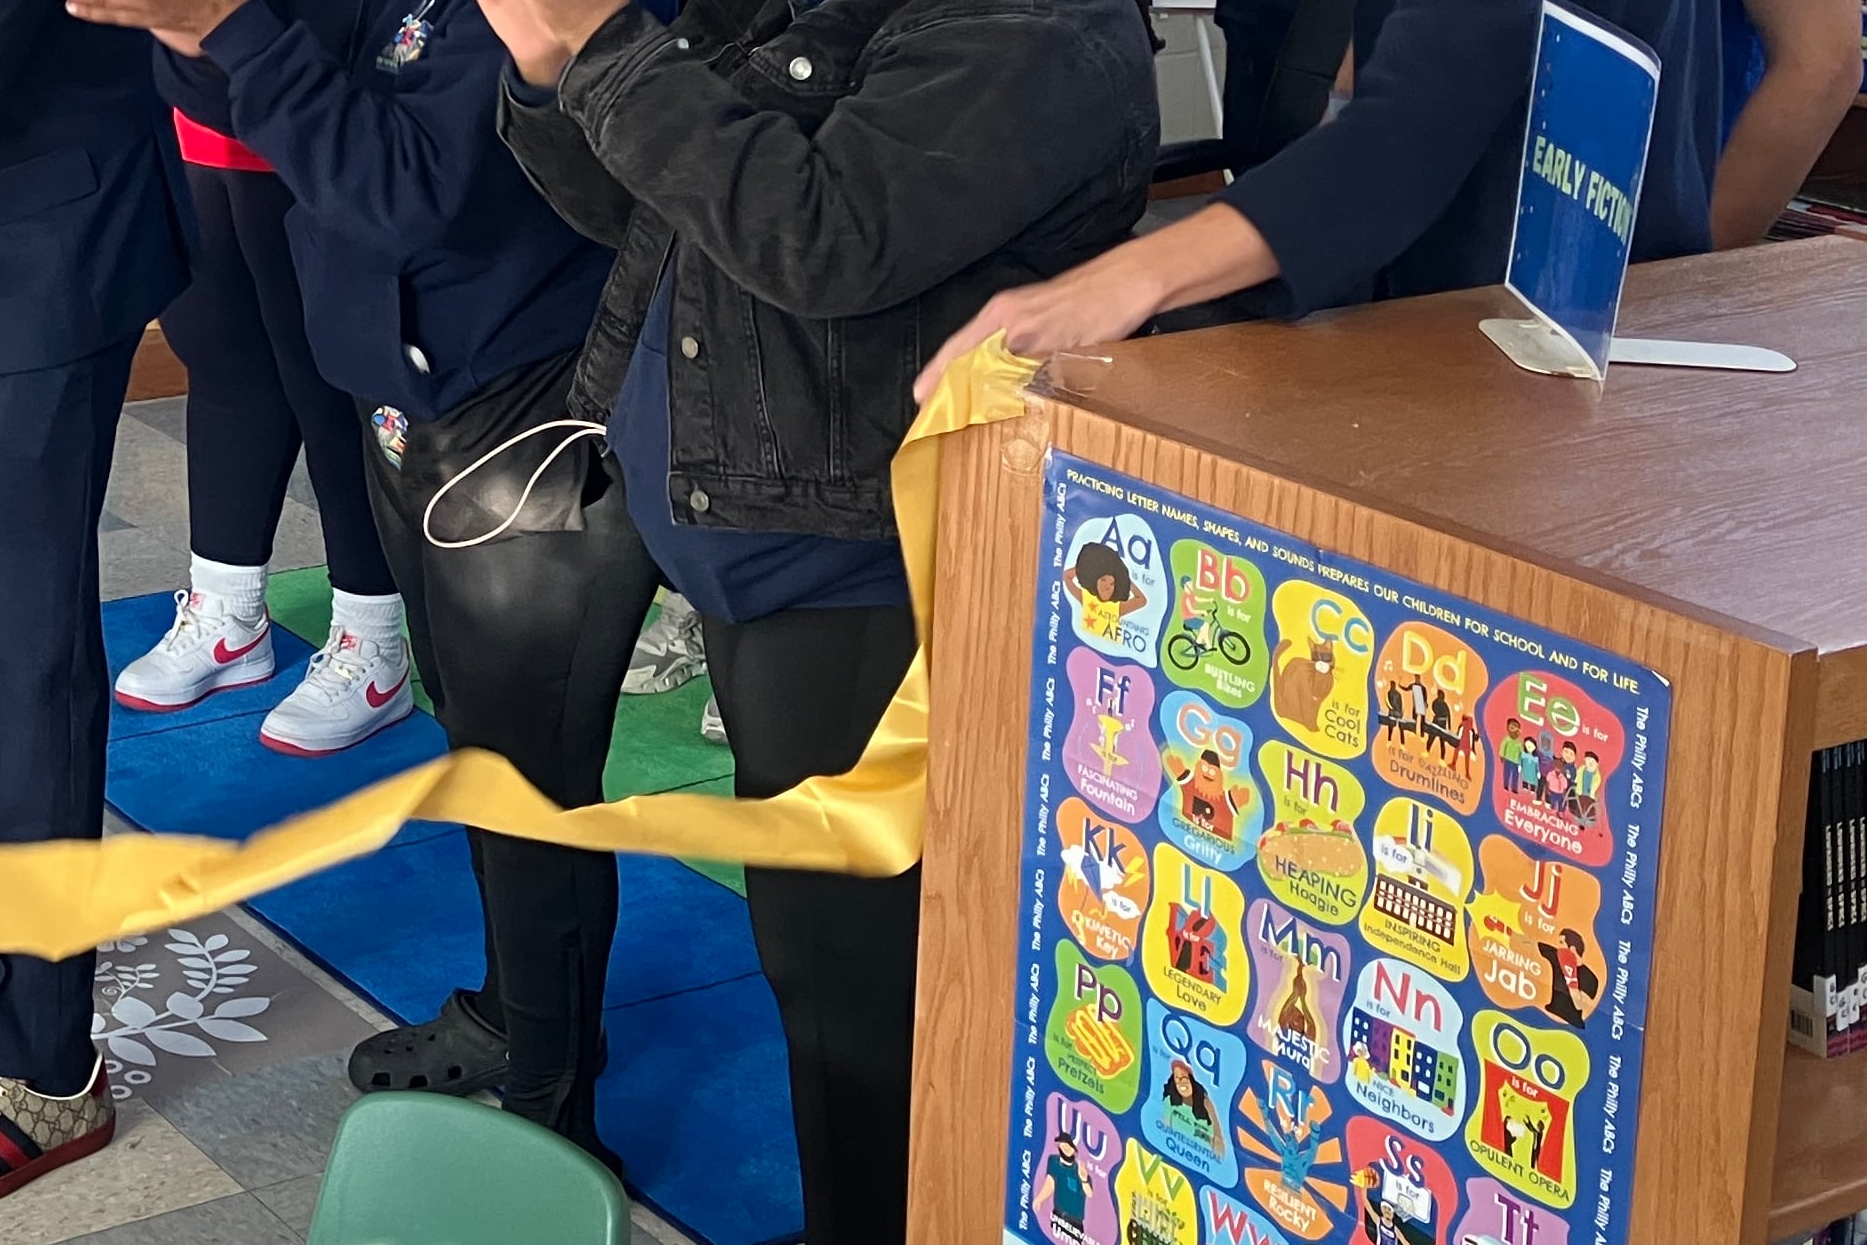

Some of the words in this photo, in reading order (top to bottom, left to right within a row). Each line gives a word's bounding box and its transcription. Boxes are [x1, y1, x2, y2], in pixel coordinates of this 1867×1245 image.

[1533, 135, 1586, 200] EARLY
[1586, 170, 1633, 246] FICTION
[1055, 513, 1067, 545] Philly
[1100, 517, 1152, 570] Aa
[1054, 550, 1063, 567] The
[1067, 469, 1123, 500] PRACTICING
[1127, 491, 1159, 511] LETTER
[1162, 506, 1199, 530] NAMES,
[1203, 520, 1241, 546] SHAPES,
[1245, 536, 1268, 553] AND
[1273, 546, 1314, 572] SOUNDS
[1318, 564, 1369, 593] PREPARES
[1374, 585, 1398, 603] OUR
[1402, 596, 1460, 626] CHILDREN
[1465, 618, 1489, 637] FOR
[1493, 629, 1545, 659] SCHOOL
[1549, 650, 1578, 669] AND
[1583, 662, 1609, 683] FOR
[1196, 548, 1251, 604] Bb
[1048, 612, 1060, 644] Philly
[1102, 624, 1146, 652] AFRO
[1047, 646, 1057, 665] The
[1402, 630, 1467, 695] Dd
[1095, 667, 1131, 716] Ff
[1204, 663, 1255, 693] BUSTLING
[1216, 679, 1242, 698] Bikes
[1324, 709, 1360, 734] Cool
[1332, 700, 1339, 710] is
[1345, 702, 1360, 718] for
[1517, 671, 1581, 737] Ee
[1636, 706, 1649, 730] The
[1043, 708, 1054, 738] Philly
[1177, 703, 1244, 770] Gg
[1324, 725, 1359, 748] Cats
[1582, 724, 1590, 736] is
[1593, 726, 1610, 743] for
[1042, 741, 1051, 761] The
[1631, 733, 1647, 771] Philly
[1078, 764, 1138, 801] FASCINATING
[1080, 778, 1136, 816] Fountain
[1285, 749, 1339, 813] Hh
[1390, 759, 1465, 804] Drumlines
[1630, 773, 1643, 809] ABCs
[1038, 804, 1050, 834] Philly
[1283, 796, 1290, 807] is
[1293, 801, 1307, 817] for
[1510, 799, 1580, 836] EMBRACING
[1037, 840, 1047, 856] The
[1172, 817, 1235, 854] GREGARIOUS
[1504, 809, 1583, 855] Everyone
[1627, 824, 1640, 847] The
[1184, 835, 1223, 865] Gritty
[1381, 843, 1389, 855] is
[1391, 848, 1407, 864] for
[1275, 855, 1357, 908] HEAPING
[1621, 850, 1638, 888] Philly
[1289, 880, 1339, 916] Hoagie
[1519, 860, 1562, 918] Jj
[1032, 899, 1044, 931] Philly
[1524, 911, 1532, 926] is
[1537, 918, 1555, 935] for
[1620, 889, 1634, 925] ABCs
[1032, 932, 1041, 951] The
[1085, 917, 1131, 949] KINETIC
[1097, 936, 1119, 959] Key
[1259, 902, 1341, 982] Mm
[1363, 923, 1438, 963] Independence
[1440, 957, 1461, 975] Hall
[1385, 920, 1441, 953] INSPIRING
[1483, 940, 1541, 976] JARRING
[1617, 939, 1631, 963] The
[1074, 963, 1123, 1024] Pp
[1163, 966, 1222, 1005] LEGENDARY
[1374, 960, 1443, 1033] Nn
[1484, 960, 1536, 1000] Jab
[1613, 966, 1628, 1004] Philly
[1029, 993, 1040, 1023] Philly
[1176, 984, 1207, 1012] Love
[1366, 1001, 1373, 1010] is
[1375, 1003, 1391, 1018] for
[1028, 1024, 1037, 1045] The
[1258, 1014, 1331, 1063] MAJESTIC
[1611, 1005, 1625, 1040] ABCs
[1161, 1013, 1221, 1088] Qq
[1272, 1036, 1315, 1075] Mural
[1489, 1022, 1566, 1092] Oo
[1608, 1055, 1621, 1079] The
[1058, 1057, 1105, 1095] Pretzels
[1373, 1080, 1395, 1096] NICE
[1511, 1076, 1519, 1089] is
[1522, 1081, 1539, 1098] for
[1024, 1085, 1036, 1116] Philly
[1356, 1083, 1435, 1134] Neighbors
[1603, 1081, 1619, 1119] Philly
[1023, 1119, 1033, 1137] The
[1602, 1119, 1615, 1154] ABCs
[1165, 1136, 1210, 1173] Queen
[1469, 1139, 1524, 1178] OPULENT
[1528, 1172, 1570, 1203] OPERA
[1020, 1178, 1031, 1209] Philly
[1395, 1180, 1403, 1191] is
[1405, 1183, 1420, 1199] for
[1599, 1168, 1612, 1191] The
[1263, 1179, 1317, 1221] RESILIENT
[1594, 1194, 1610, 1232] Philly
[1019, 1211, 1028, 1230] The
